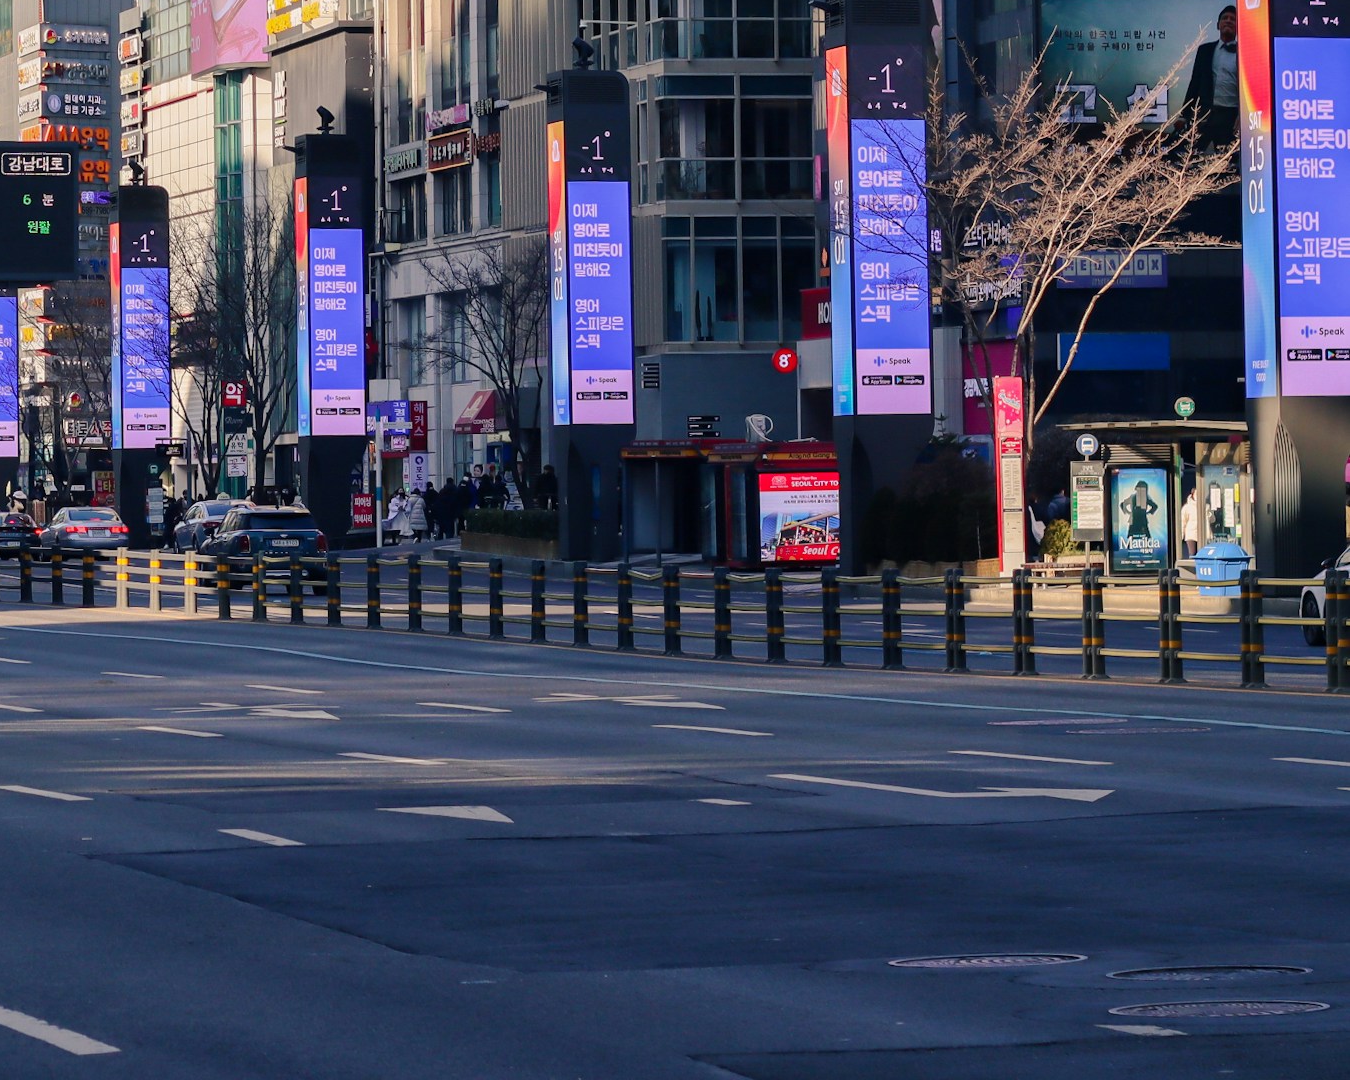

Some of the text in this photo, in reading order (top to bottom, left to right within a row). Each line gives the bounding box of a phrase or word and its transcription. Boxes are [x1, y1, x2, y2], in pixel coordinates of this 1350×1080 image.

[1089, 30, 1117, 39] 한국인
[1148, 30, 1166, 39] 사건
[1136, 42, 1155, 51] 한다
[1281, 69, 1317, 90] 이제
[1282, 99, 1335, 120] 영어로
[1248, 110, 1263, 131] SAT
[1283, 128, 1350, 150] 미친듯이
[857, 146, 888, 164] 이제
[1249, 135, 1265, 172] 15
[8, 156, 65, 172] 강남대로
[1283, 157, 1336, 179] 말해요
[858, 170, 903, 188] 영어로
[22, 193, 54, 206] 6 분
[1249, 178, 1266, 214] 01
[573, 203, 597, 218] 이제
[27, 220, 51, 234] 원활
[860, 219, 904, 236] 말해요
[1285, 210, 1320, 232] 영어
[573, 223, 611, 238] 영어로
[314, 247, 336, 260] 이제
[574, 243, 623, 258] 미친듯이
[1285, 236, 1350, 258] 스피킹은
[314, 264, 347, 277] 영어로
[574, 262, 611, 277] 말해요
[860, 262, 890, 279] 영어
[1286, 263, 1321, 285] 스픽
[125, 284, 145, 295] 이제
[314, 281, 357, 294] 미친듯이
[860, 283, 920, 302] 스피킹은
[125, 299, 153, 310] 영어로
[315, 298, 347, 311] 말해요
[575, 299, 600, 314] 영어
[861, 305, 891, 323] 스픽
[575, 316, 625, 331] 스피킹은
[315, 328, 337, 341] 영어
[1318, 327, 1345, 337] Speak
[576, 334, 601, 349] 스픽
[315, 343, 358, 357] 스피킹은
[315, 359, 337, 372] 스픽
[889, 357, 912, 366] Speak
[126, 381, 146, 393] 스픽
[413, 402, 424, 436] 해커스
[802, 544, 829, 556] Seoul
[1120, 535, 1160, 550] Matilda
